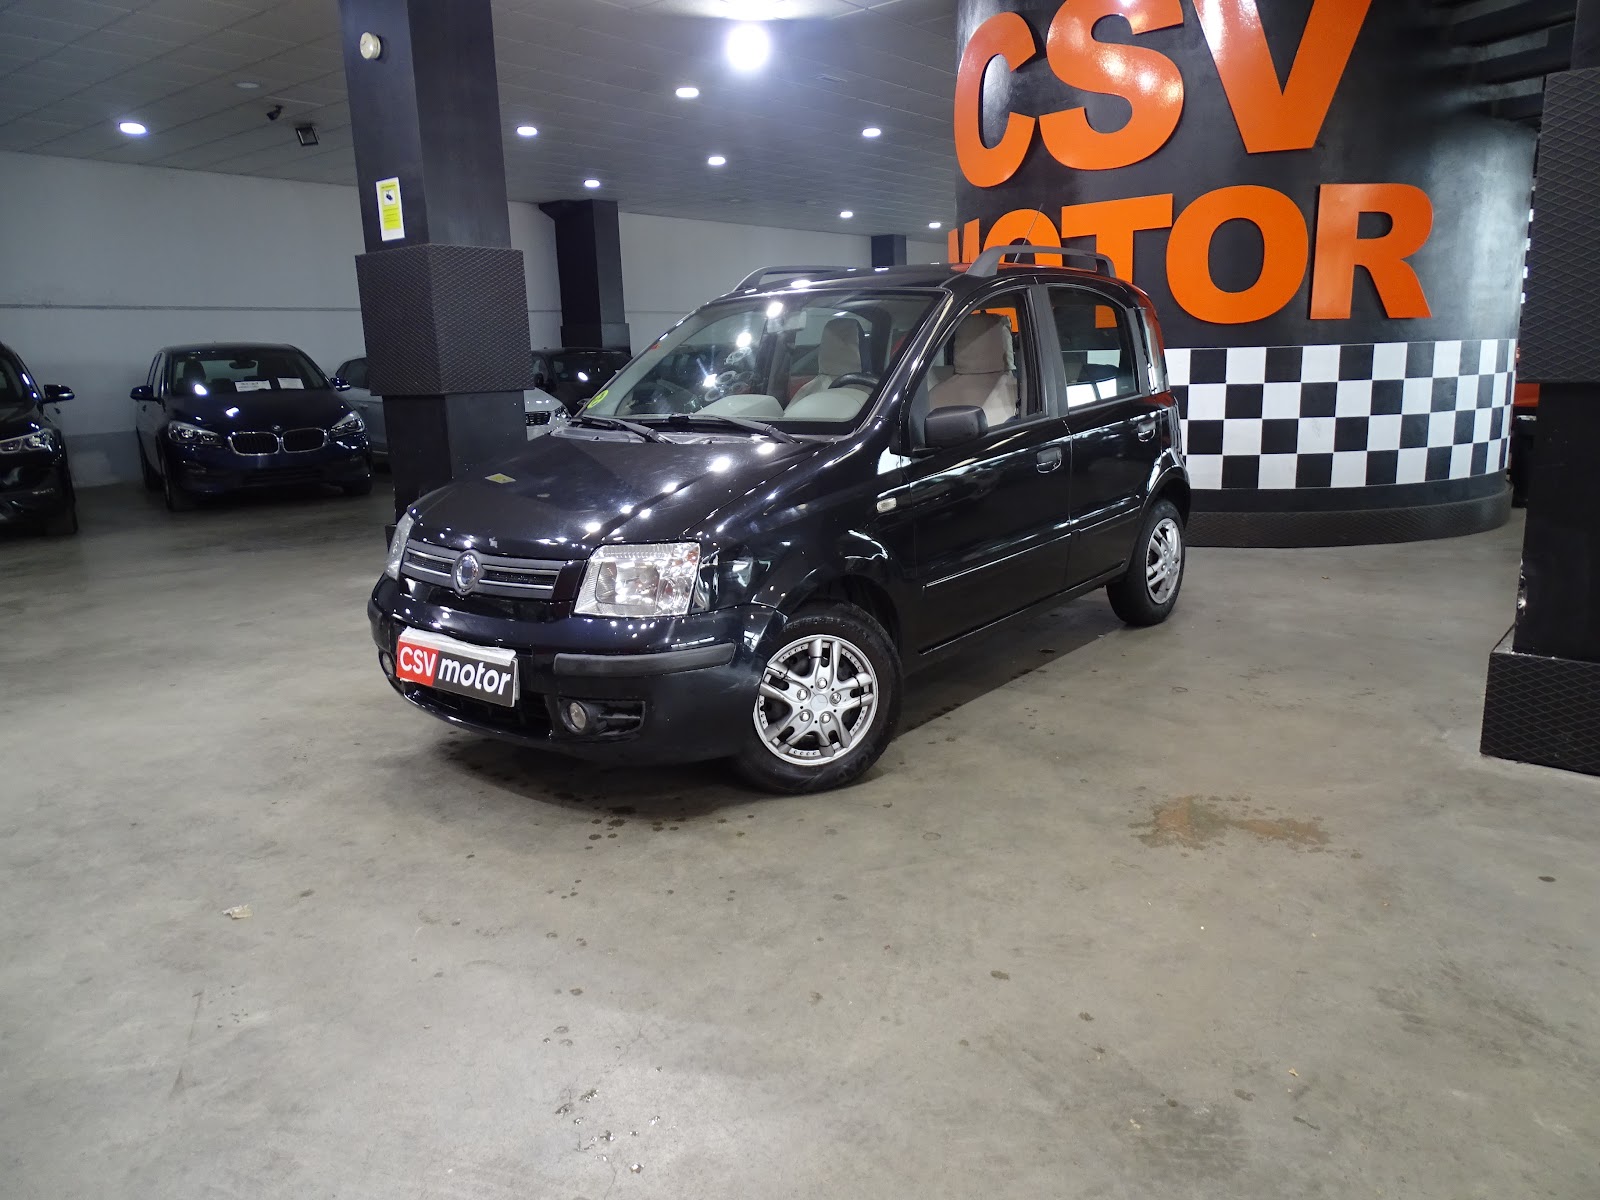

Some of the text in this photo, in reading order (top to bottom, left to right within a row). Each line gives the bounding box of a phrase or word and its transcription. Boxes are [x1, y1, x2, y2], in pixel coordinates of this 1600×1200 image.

[953, 0, 1373, 188] CSV
[400, 646, 511, 695] CSV motor
